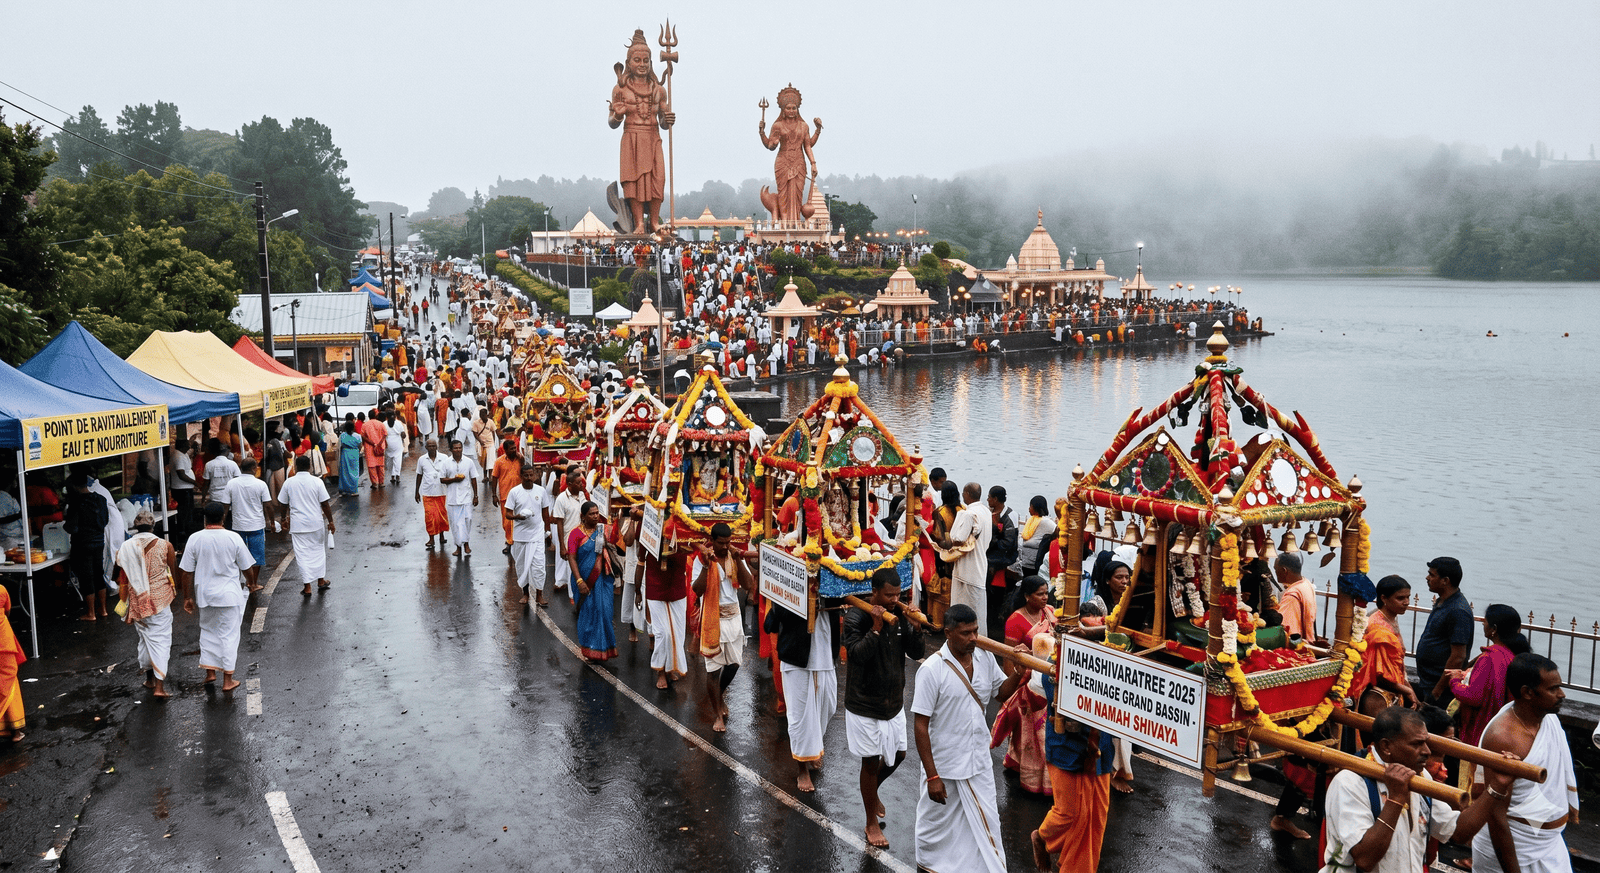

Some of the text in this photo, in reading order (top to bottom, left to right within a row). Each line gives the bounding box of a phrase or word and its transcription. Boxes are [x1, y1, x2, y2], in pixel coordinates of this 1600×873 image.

[44, 410, 157, 438] POINT DE RAVITAILLEMENT
[62, 440, 80, 458] EAU
[84, 438, 94, 455] ET
[98, 430, 148, 452] NOURRITURE
[1068, 648, 1196, 706] MAHASHIVARATREE 2025
[1077, 694, 1178, 746] OM NAMAH SHIVAYA
[1122, 690, 1153, 713] GRAND
[1156, 702, 1190, 727] BASSIN
